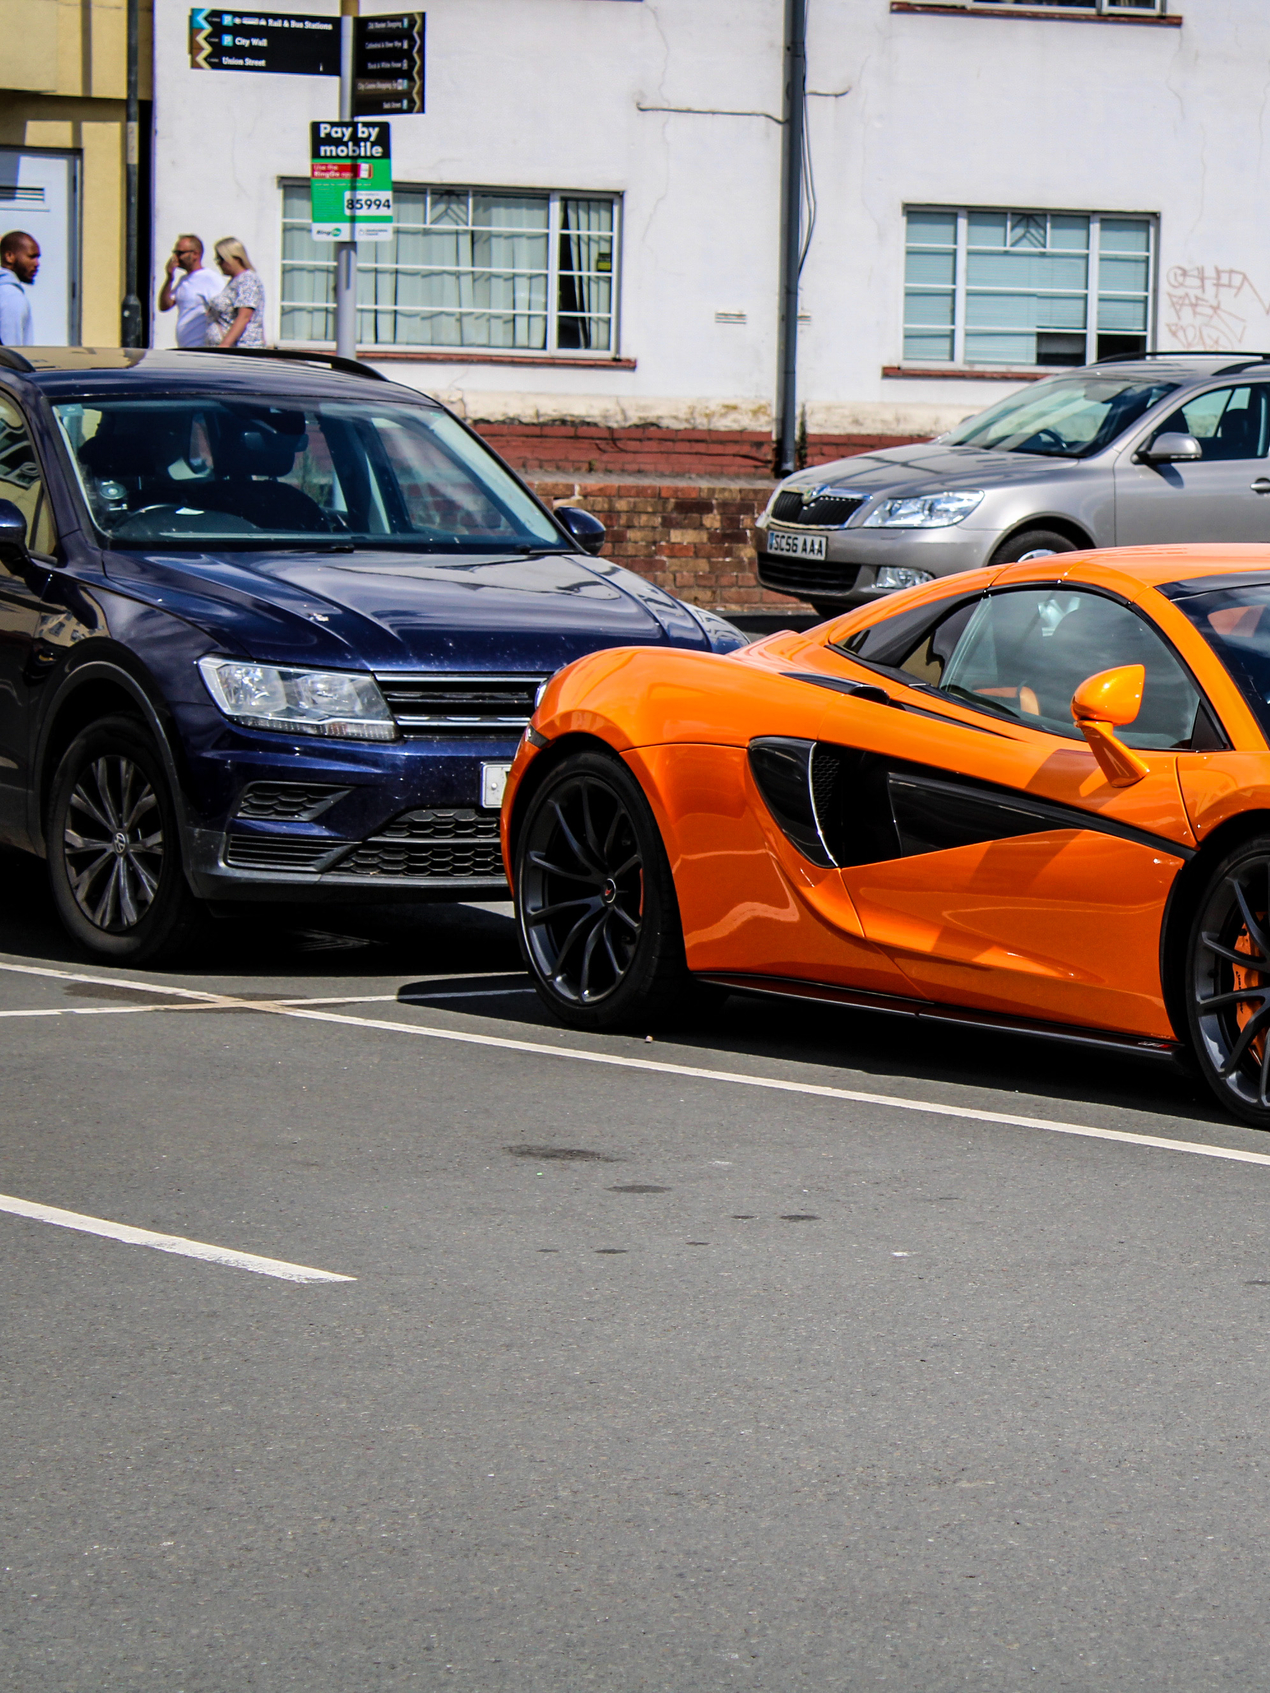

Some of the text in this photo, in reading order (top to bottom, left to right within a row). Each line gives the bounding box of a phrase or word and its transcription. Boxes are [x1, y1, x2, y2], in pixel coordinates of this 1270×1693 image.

[268, 18, 282, 28] Rail
[283, 19, 290, 28] &
[290, 20, 304, 29] Bus
[304, 21, 333, 30] Stations
[234, 37, 250, 48] City
[251, 38, 268, 47] Wall
[222, 57, 244, 66] Union
[245, 58, 266, 67] Street
[319, 122, 380, 142] Pay by
[319, 141, 384, 157] mobile
[345, 198, 391, 210] 85994
[773, 534, 824, 557] SC56 AAA
